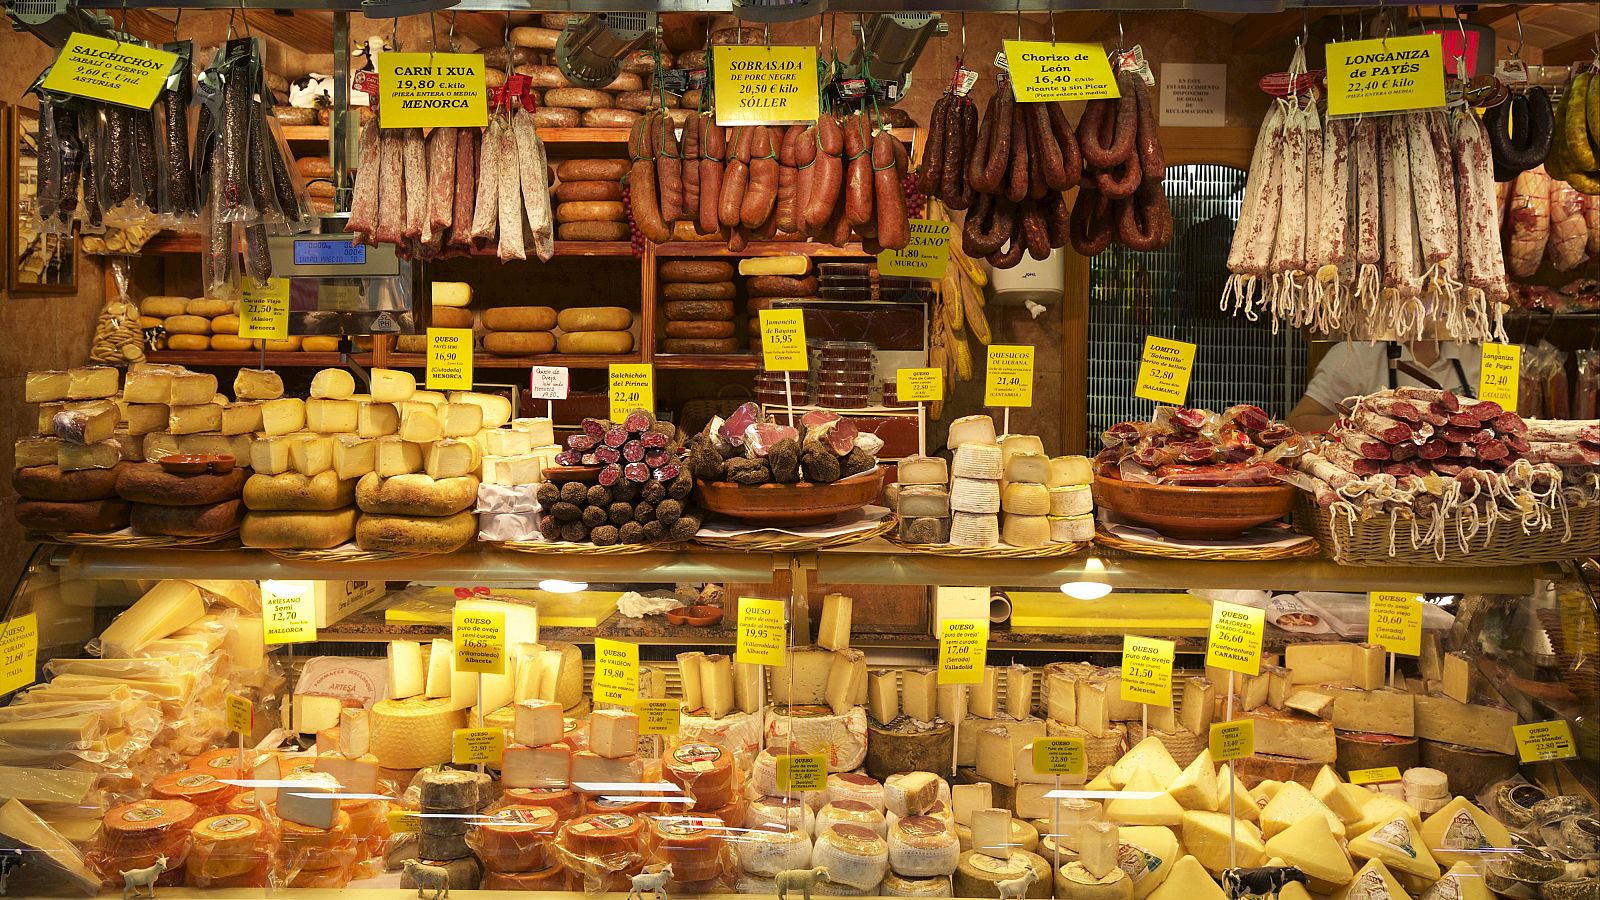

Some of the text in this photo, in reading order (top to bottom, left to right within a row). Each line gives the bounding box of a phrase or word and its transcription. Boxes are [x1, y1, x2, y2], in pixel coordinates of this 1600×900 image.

[72, 46, 164, 70] SALCHICHÓN
[1345, 50, 1430, 65] LONGANIZA
[69, 56, 103, 66] JABALÍ
[114, 65, 148, 76] CIERVO
[730, 61, 802, 70] SOBRASADA
[1350, 62, 1419, 78] de PAYÉS
[76, 66, 139, 84] 9,60 Und.
[394, 67, 475, 76] CARN I XUA
[73, 76, 121, 89] ASTURIAS
[397, 80, 435, 90] 19,80
[1034, 76, 1070, 84] 16,40
[1348, 78, 1414, 92] 22,40 € kilo
[740, 84, 798, 95] 20,50 € kilo
[402, 100, 469, 108] MENORCA
[740, 96, 787, 107] SÓLLER
[910, 224, 949, 234] BRILLO
[248, 305, 271, 313] 21,50
[771, 335, 792, 344] 15,95
[1150, 345, 1179, 355] LOMITO
[436, 352, 456, 361] 16,90
[1150, 368, 1173, 380] 52,80
[998, 377, 1019, 385] 21,40
[1485, 374, 1507, 385] 22,40
[1143, 384, 1179, 396] (SALAMANCA)
[615, 392, 639, 402] 22,40
[272, 612, 296, 621] 12,70
[1222, 610, 1248, 620] QUESO
[1377, 615, 1401, 624] 20,60
[1219, 619, 1252, 629] MAJORERO
[4, 626, 25, 638] QUESO
[746, 628, 768, 638] 19,95
[1219, 631, 1243, 643] 26,60
[464, 639, 487, 648] 16,85
[604, 649, 626, 657] QUESO
[948, 646, 969, 654] 17,60
[1132, 646, 1158, 654] QUESO
[1211, 643, 1254, 656] (Fuerteventura)
[5, 652, 23, 665] 21,60
[1214, 650, 1248, 662] CANARIAS
[604, 668, 624, 678] 19,80
[1130, 667, 1152, 678] 21,50
[1130, 686, 1156, 694] Palencia
